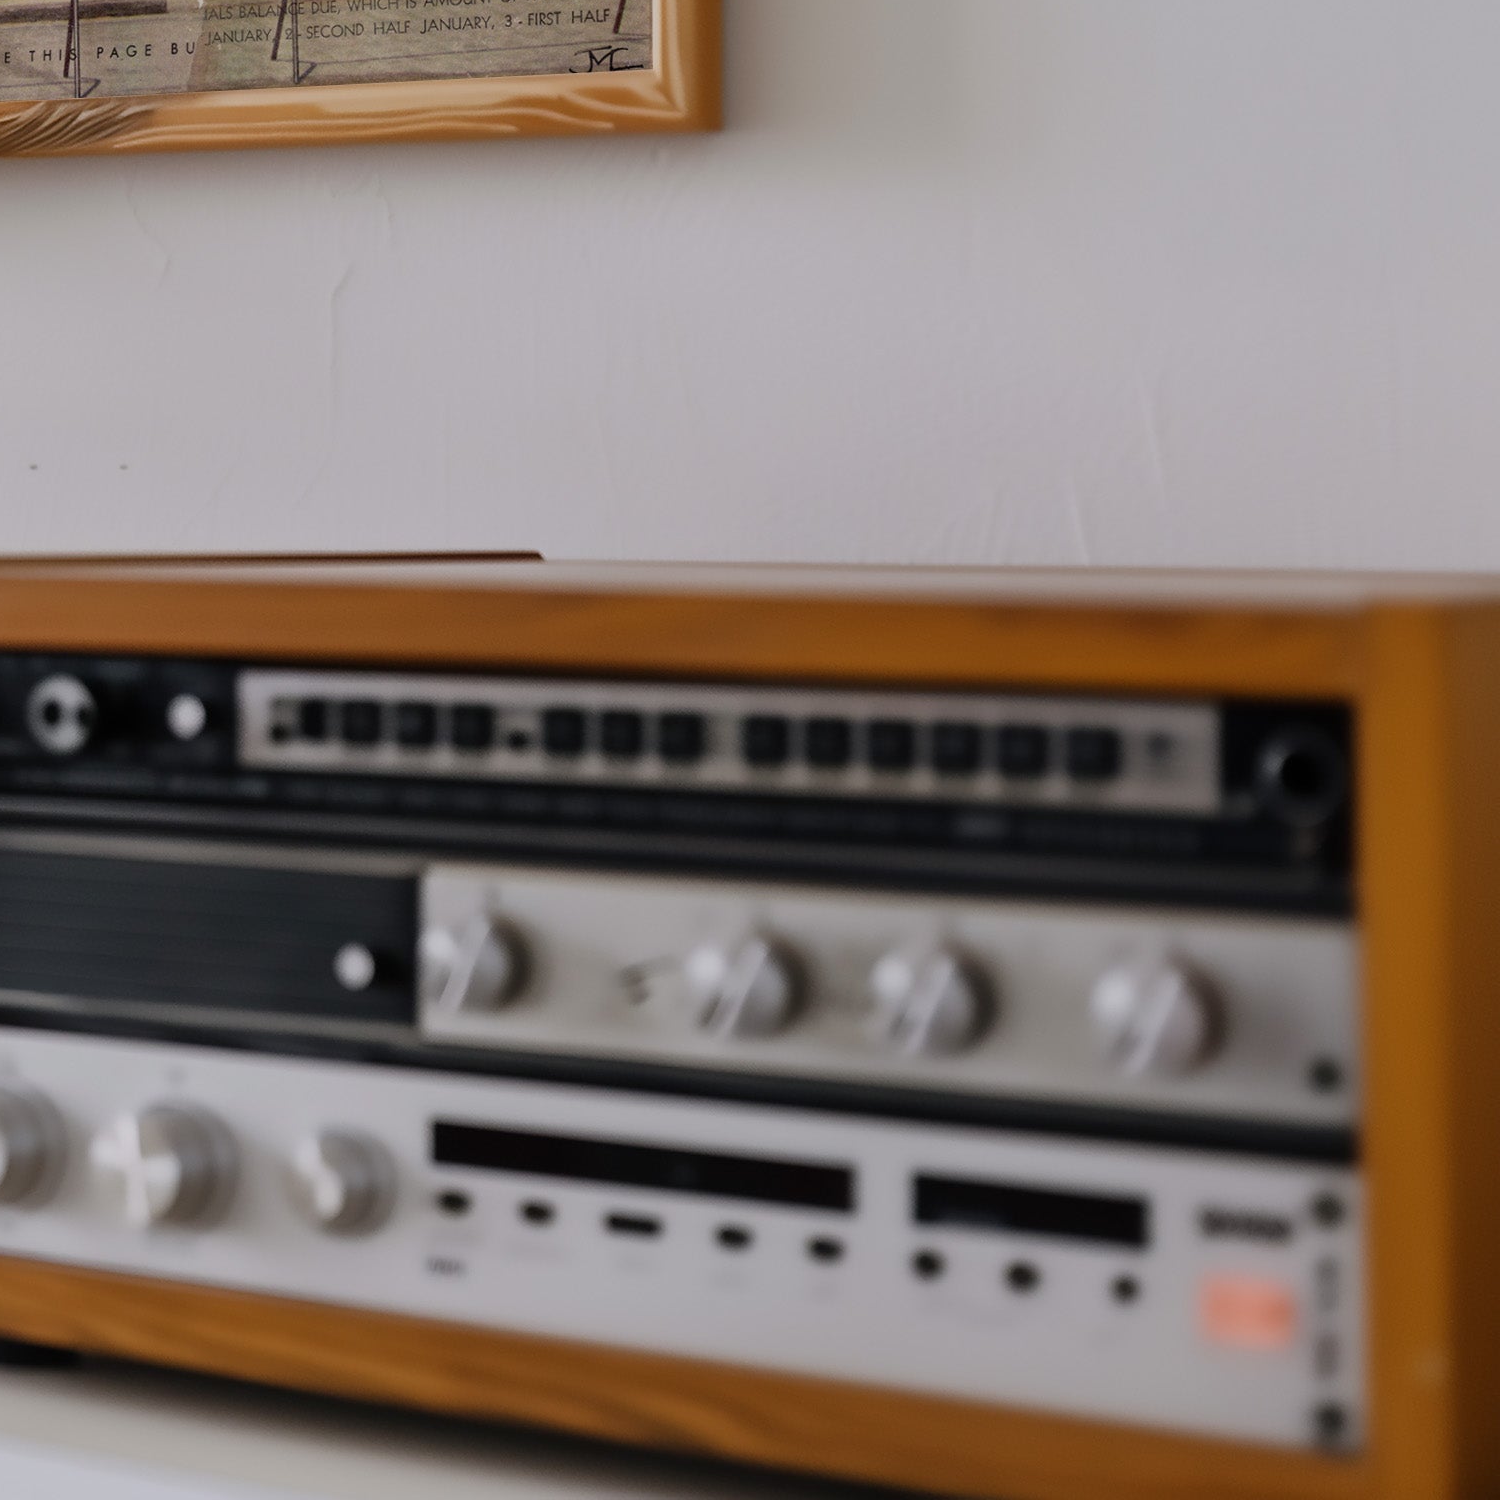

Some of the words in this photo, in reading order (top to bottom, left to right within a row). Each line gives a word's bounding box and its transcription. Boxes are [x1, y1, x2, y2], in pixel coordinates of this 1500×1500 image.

[311, 0, 341, 16] DUE,
[306, 23, 365, 40] SECOND
[373, 20, 410, 36] HALF
[420, 15, 495, 35] JANUARY,
[527, 11, 561, 26] FIRST
[571, 8, 610, 24] HALF
[29, 48, 78, 63] THIS
[97, 43, 152, 60] PAGE
[171, 42, 196, 55] BU
